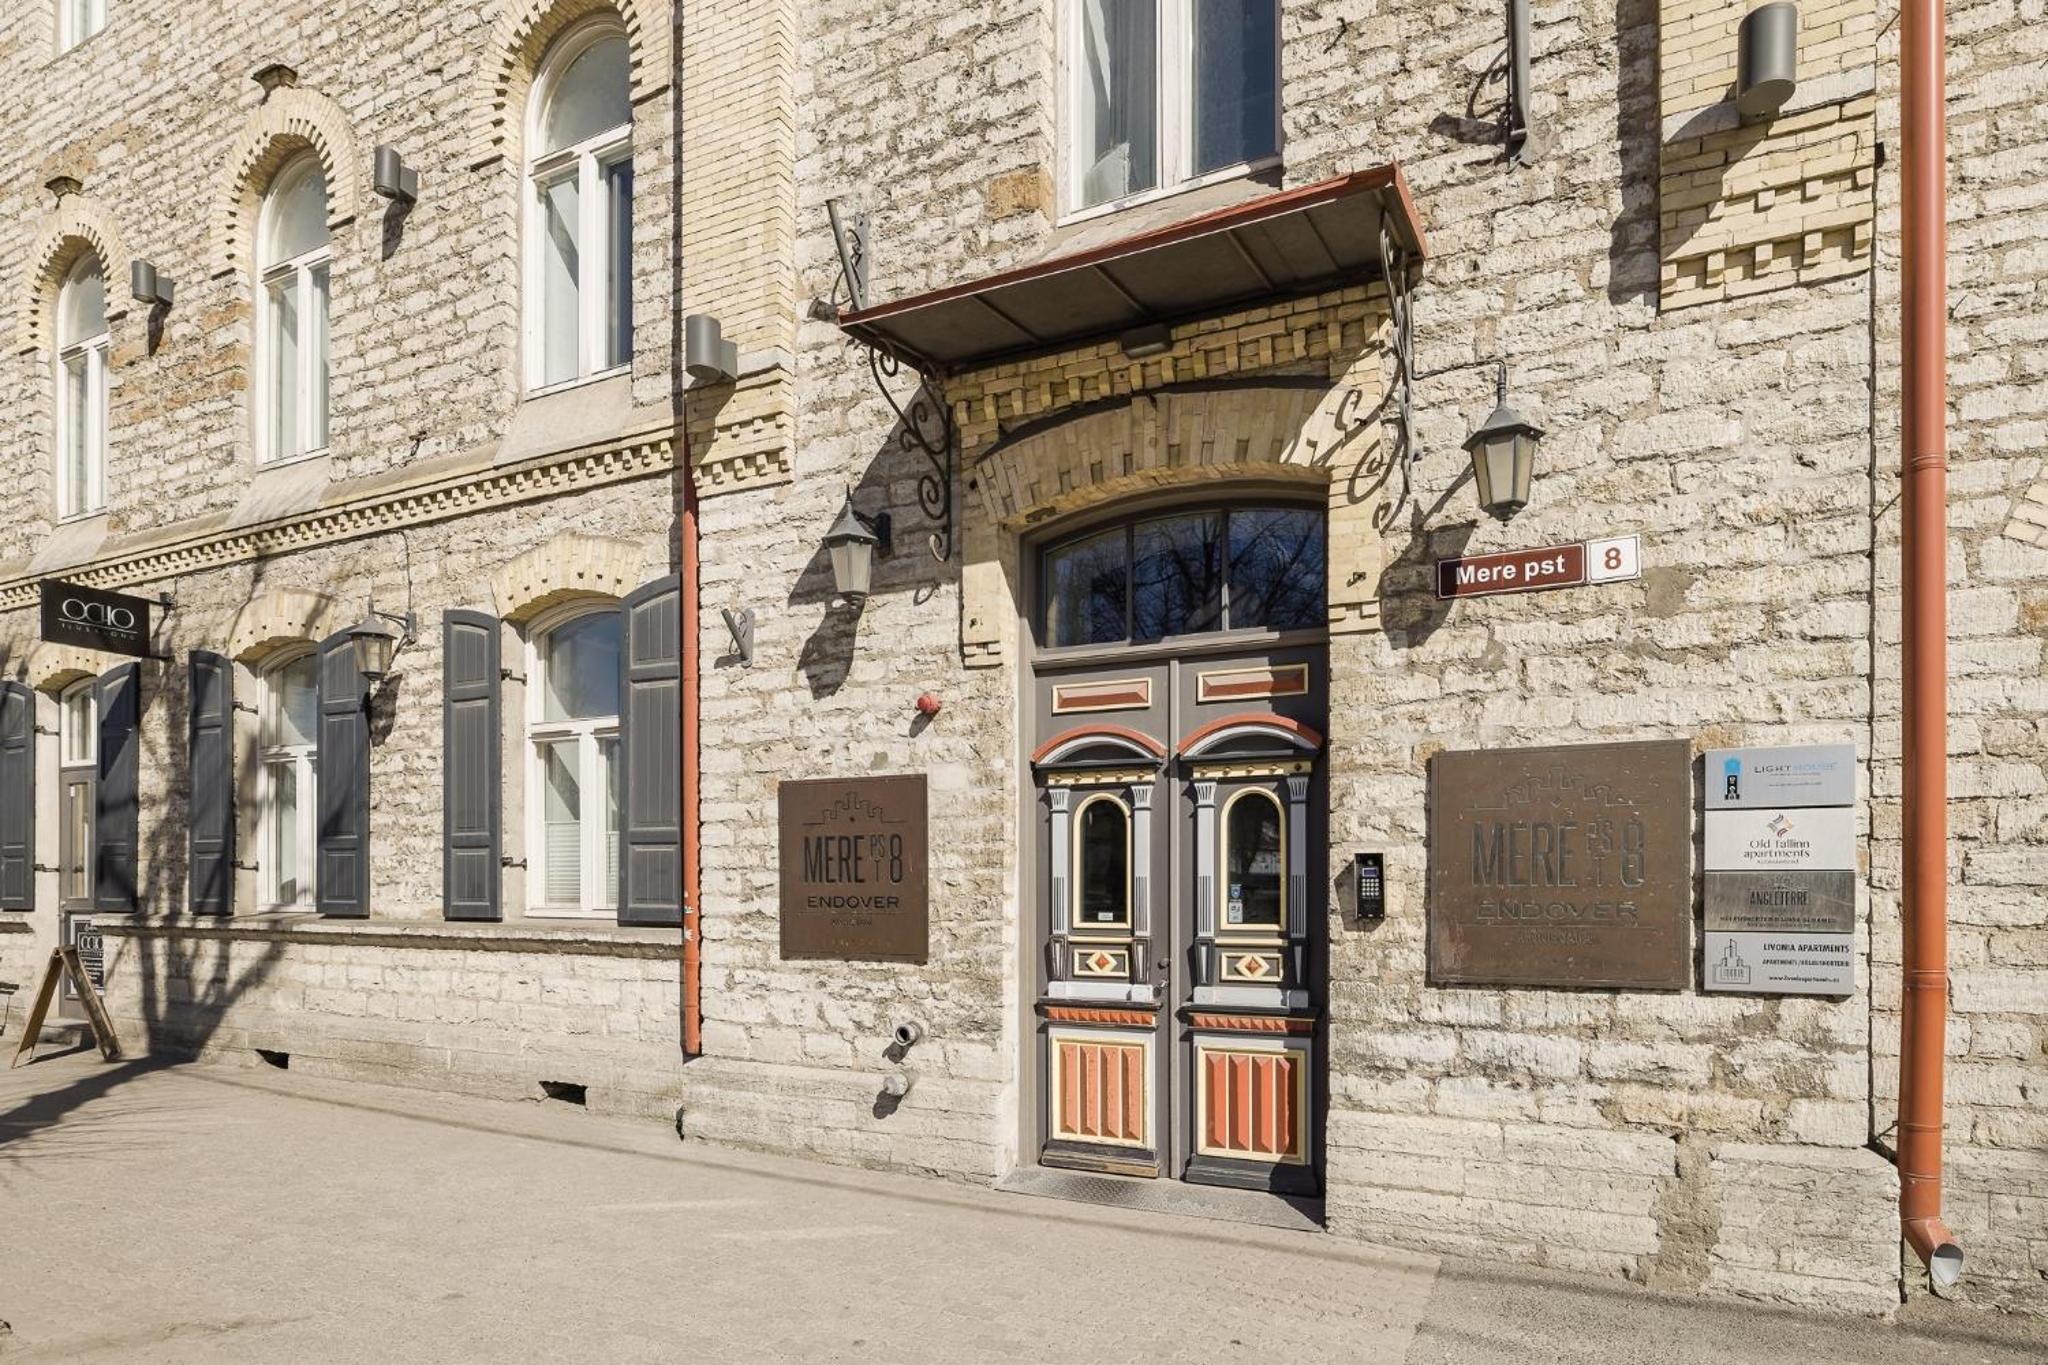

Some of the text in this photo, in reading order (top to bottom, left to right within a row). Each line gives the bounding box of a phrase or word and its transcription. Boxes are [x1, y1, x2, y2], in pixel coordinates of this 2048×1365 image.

[1456, 547, 1622, 585] Mere pst 8
[1749, 839, 1811, 849] Old Tallinn
[803, 834, 866, 884] MERE
[889, 833, 904, 884] 8
[1471, 820, 1577, 888] MERE
[1619, 819, 1646, 888] 8
[1743, 849, 1811, 860] apartments
[807, 895, 900, 909] ENDOVER
[1750, 890, 1808, 906] ANGLETERRE
[1475, 901, 1639, 923] ENDOVER
[1762, 943, 1850, 954] LIVONIA APARTMENTS
